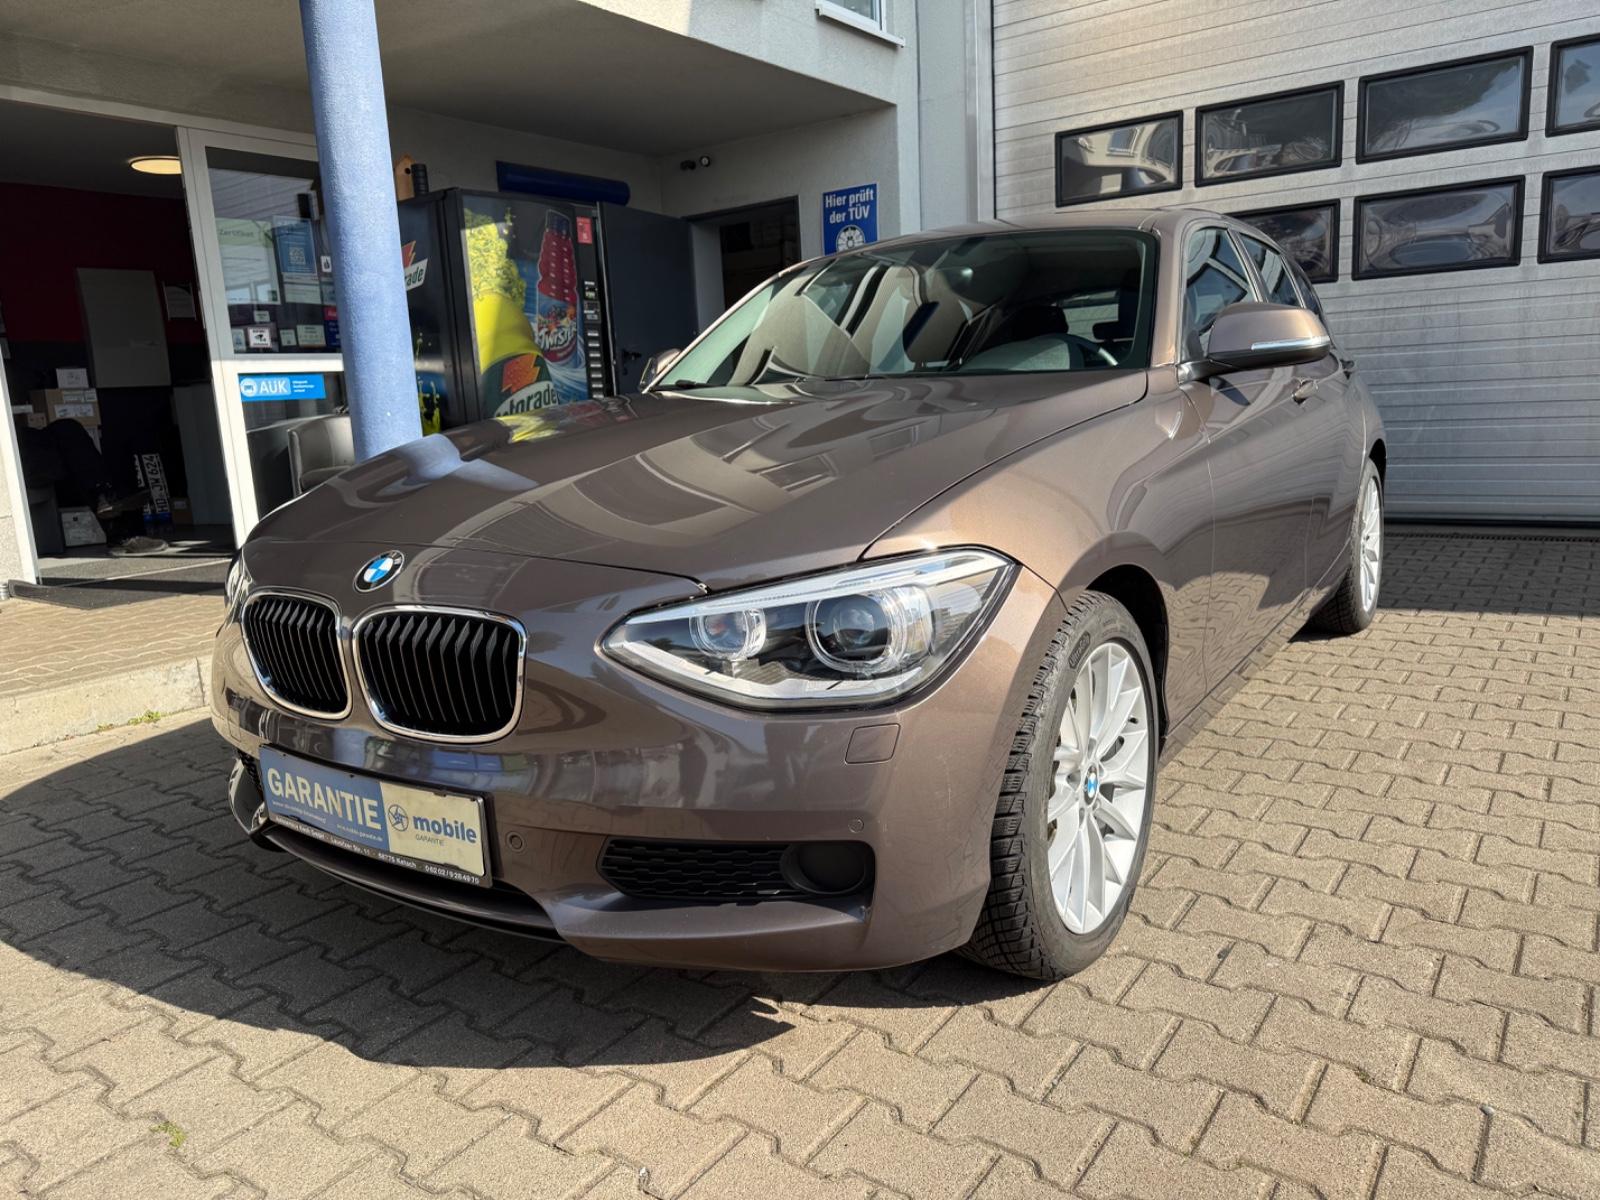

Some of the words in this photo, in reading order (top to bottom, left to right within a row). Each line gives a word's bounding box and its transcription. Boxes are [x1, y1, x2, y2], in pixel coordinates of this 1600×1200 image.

[825, 194, 847, 208] Hier
[848, 188, 874, 207] prüft
[829, 210, 847, 224] der
[848, 204, 870, 221] TÜV
[404, 266, 424, 286] ade
[496, 384, 557, 418] torade
[267, 767, 382, 831] GARANTIE
[412, 815, 477, 844] mobile
[415, 834, 445, 846] GARANTIE
